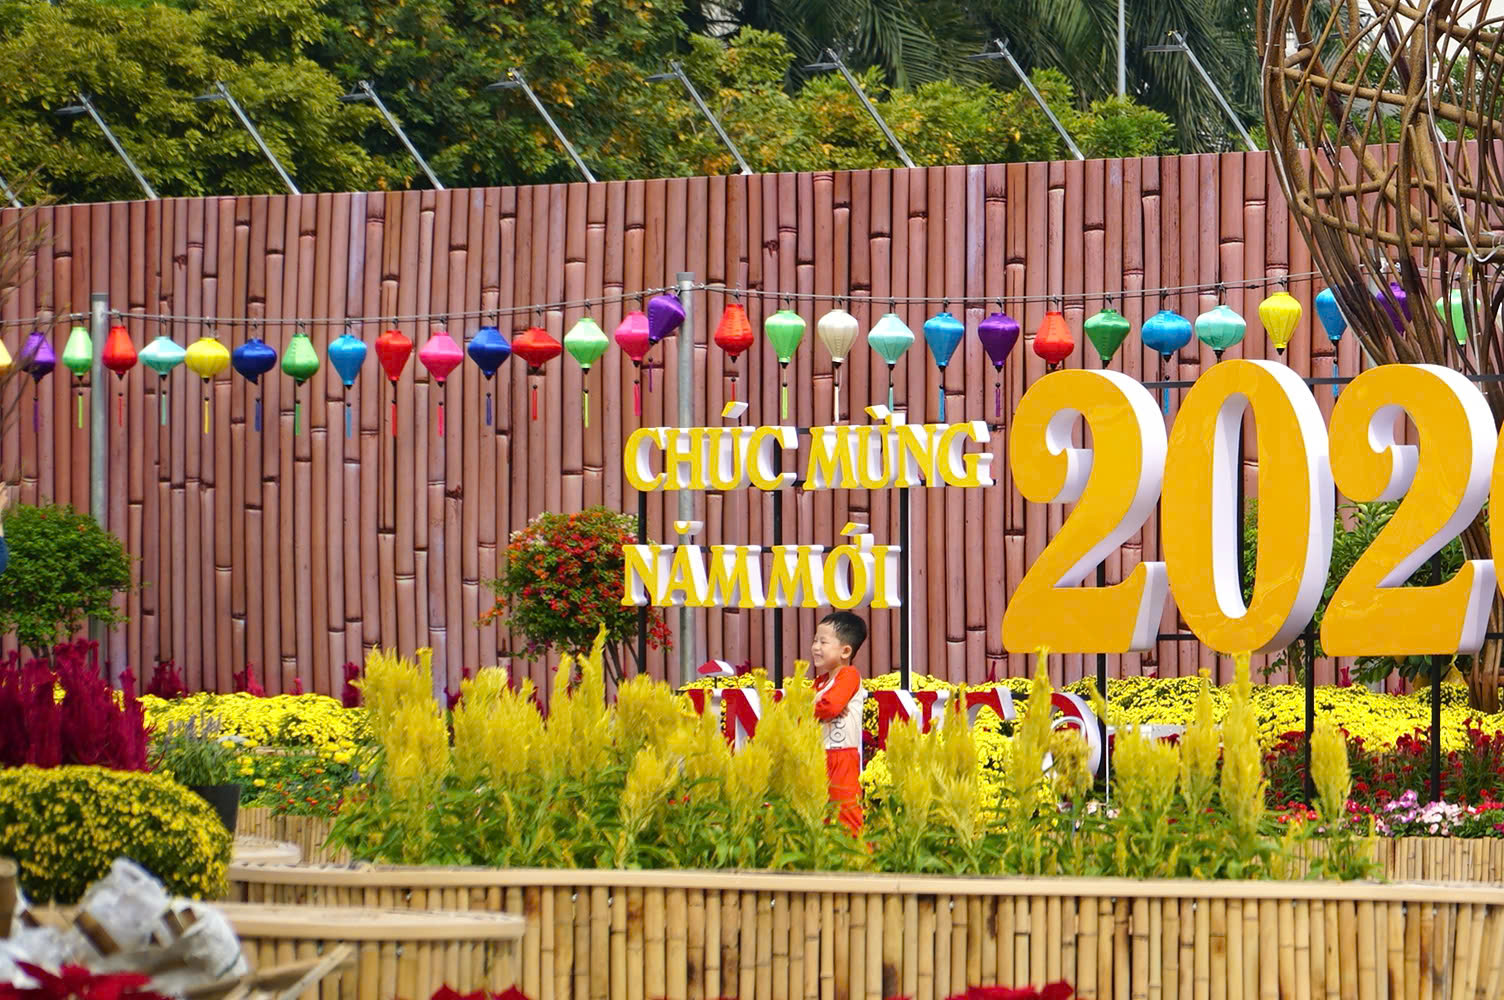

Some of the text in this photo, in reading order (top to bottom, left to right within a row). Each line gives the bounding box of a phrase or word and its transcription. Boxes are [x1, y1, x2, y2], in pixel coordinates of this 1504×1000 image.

[624, 401, 991, 491] CHÚC MỪNG
[621, 521, 901, 609] NĂM MỚI
